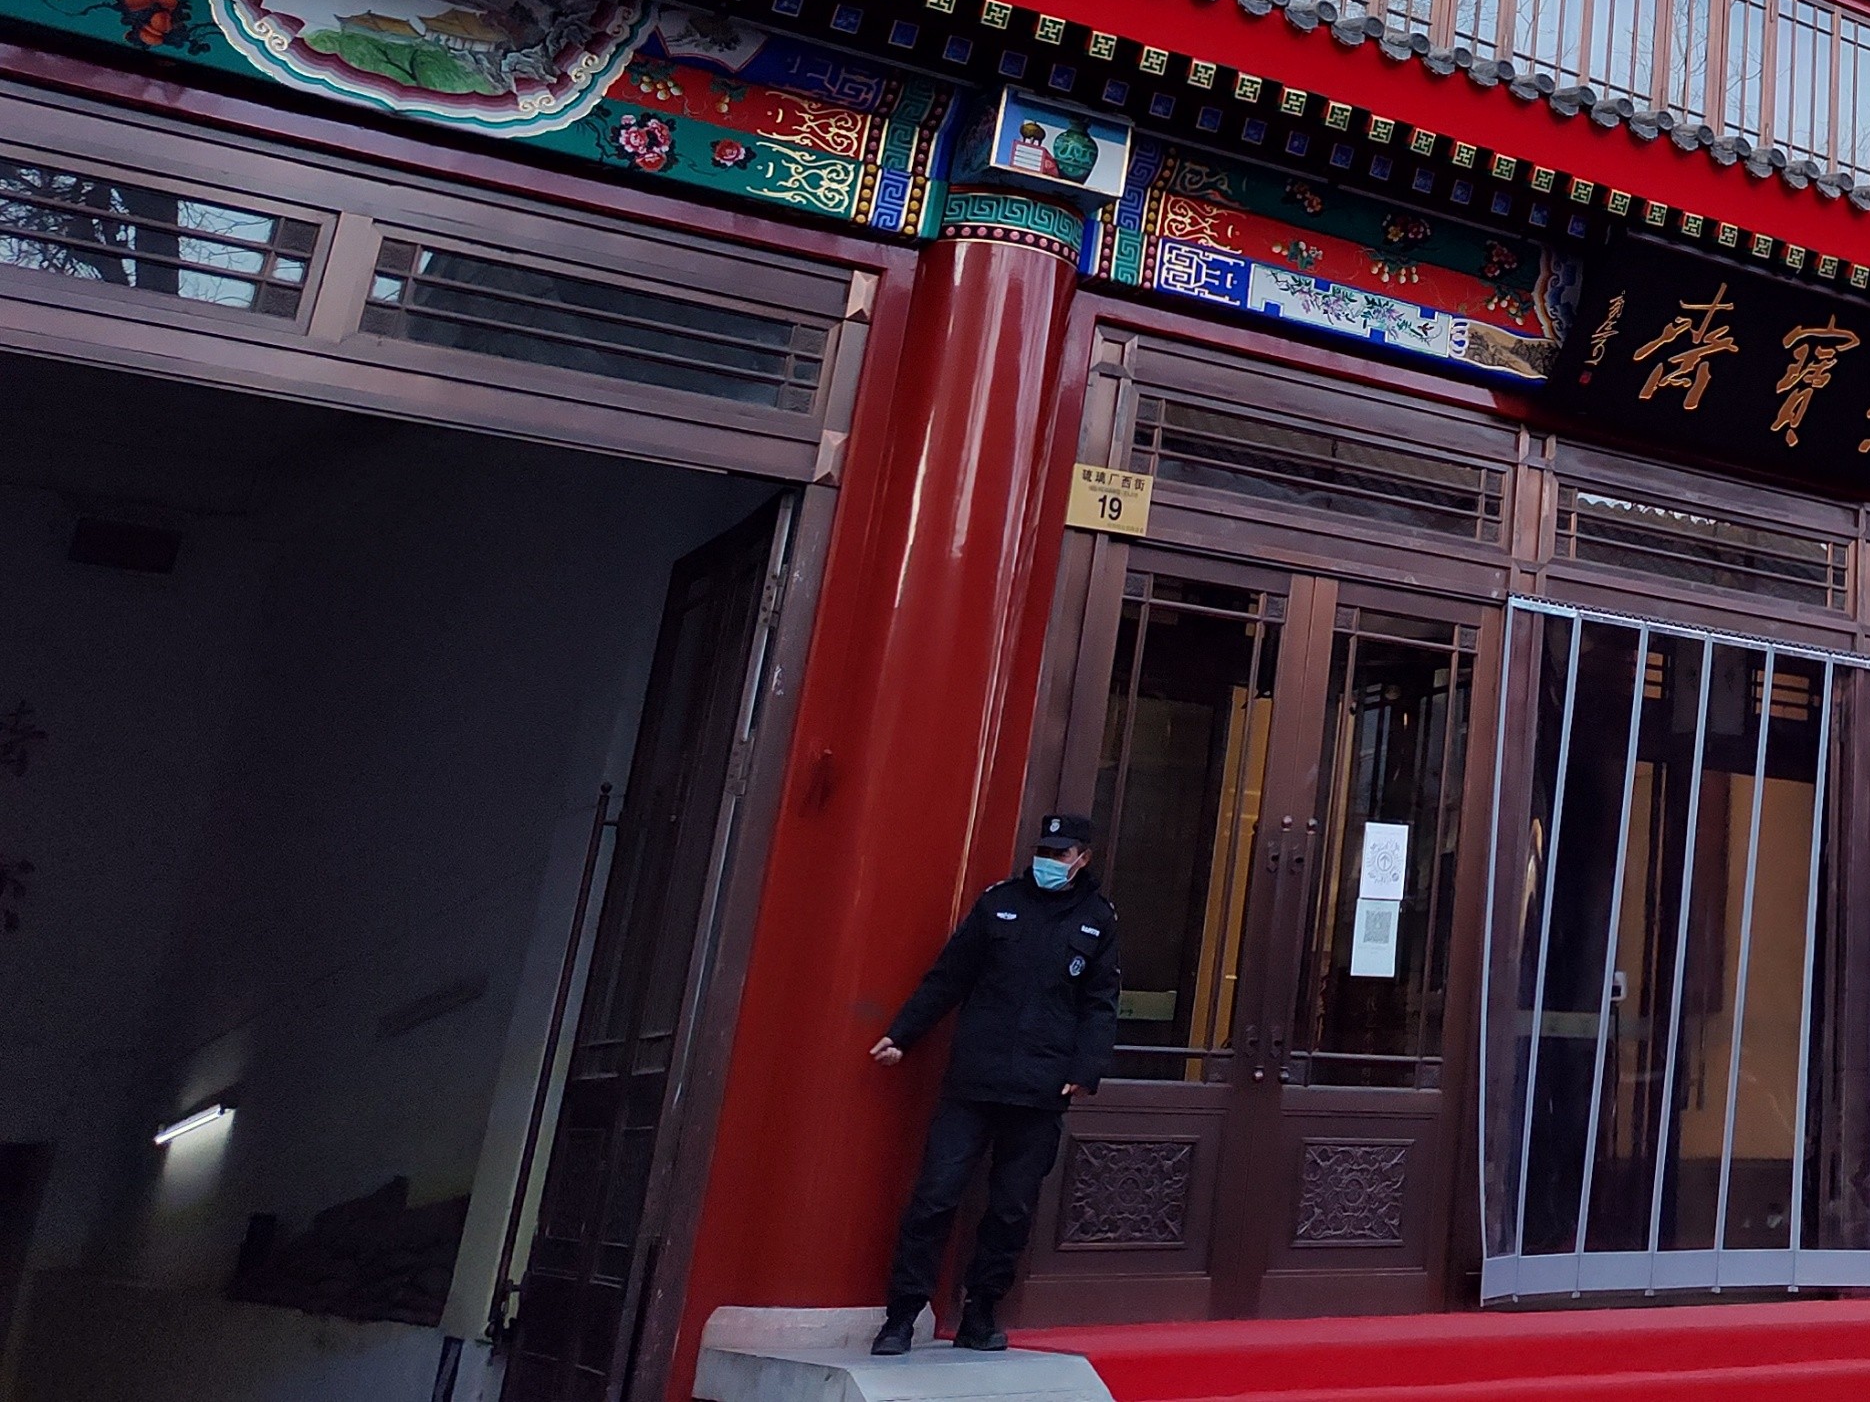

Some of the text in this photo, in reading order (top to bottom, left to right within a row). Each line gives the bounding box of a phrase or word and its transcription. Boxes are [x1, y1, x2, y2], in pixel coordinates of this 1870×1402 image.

[1082, 469, 1145, 491] 琉璃厂西街
[1098, 494, 1123, 521] 19
